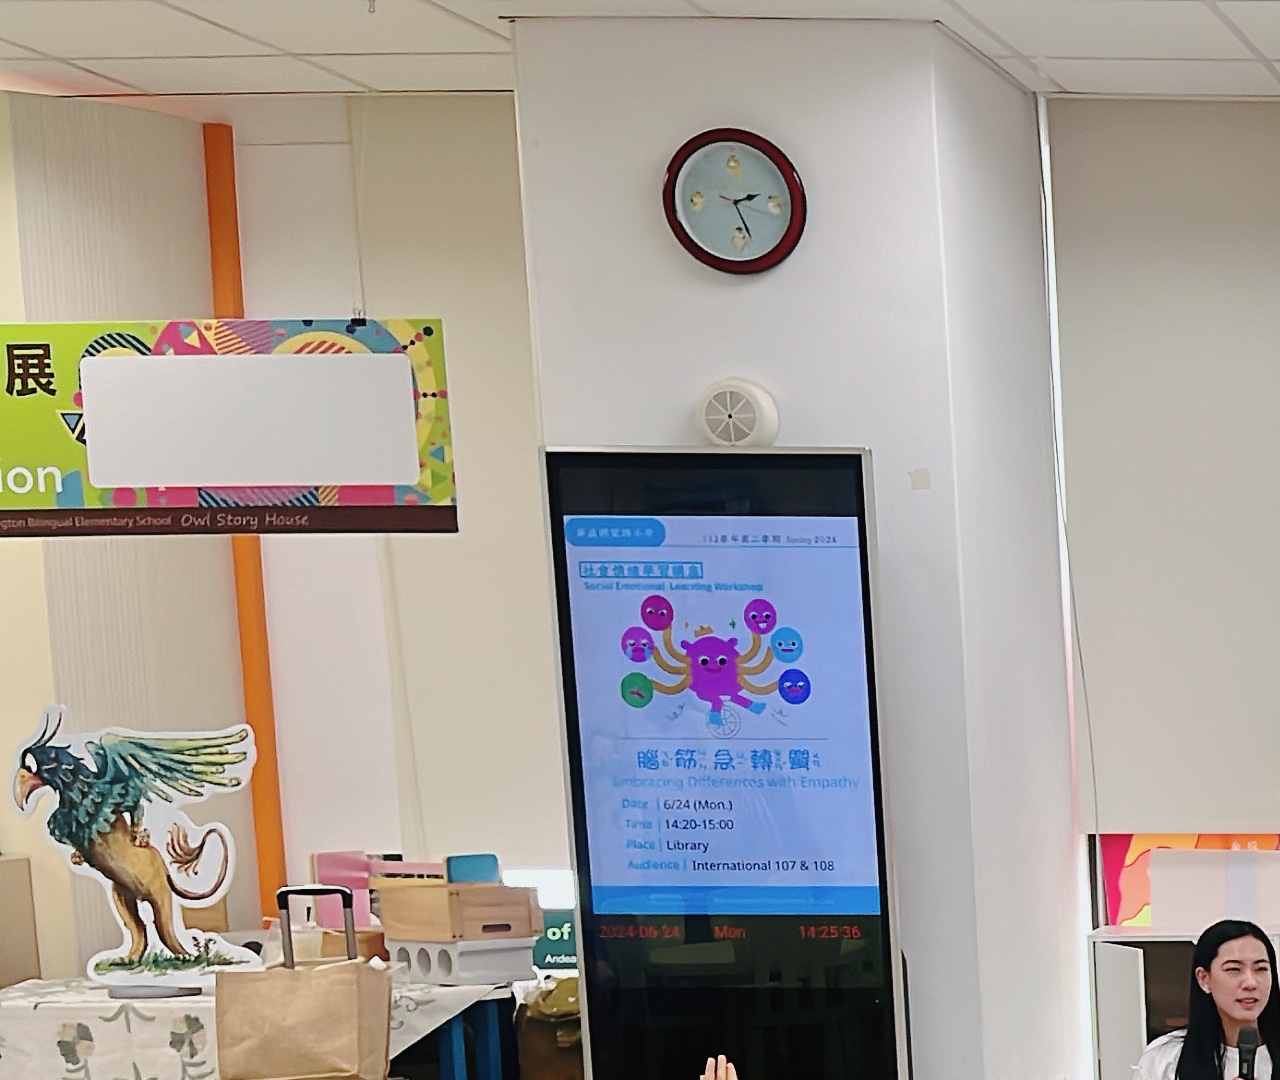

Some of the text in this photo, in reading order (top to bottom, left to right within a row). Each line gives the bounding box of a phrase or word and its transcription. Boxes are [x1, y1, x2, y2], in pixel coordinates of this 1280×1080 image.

[5, 343, 57, 397] 展
[74, 515, 133, 529] Elementary
[135, 515, 172, 527] School
[180, 513, 210, 527] Owl
[217, 513, 258, 529] Story
[264, 513, 309, 527] House
[814, 536, 837, 545] 2024
[584, 581, 763, 593] Social Emotional Learning Workshop
[612, 775, 860, 791] Embracing Differences with Empathy
[622, 799, 734, 813] Date 6/24 (Mon.)
[625, 818, 735, 831] Time 14:20-15:00
[626, 839, 709, 855] Place Library
[628, 860, 835, 872] Audience International 107 & 108
[546, 923, 572, 941] of
